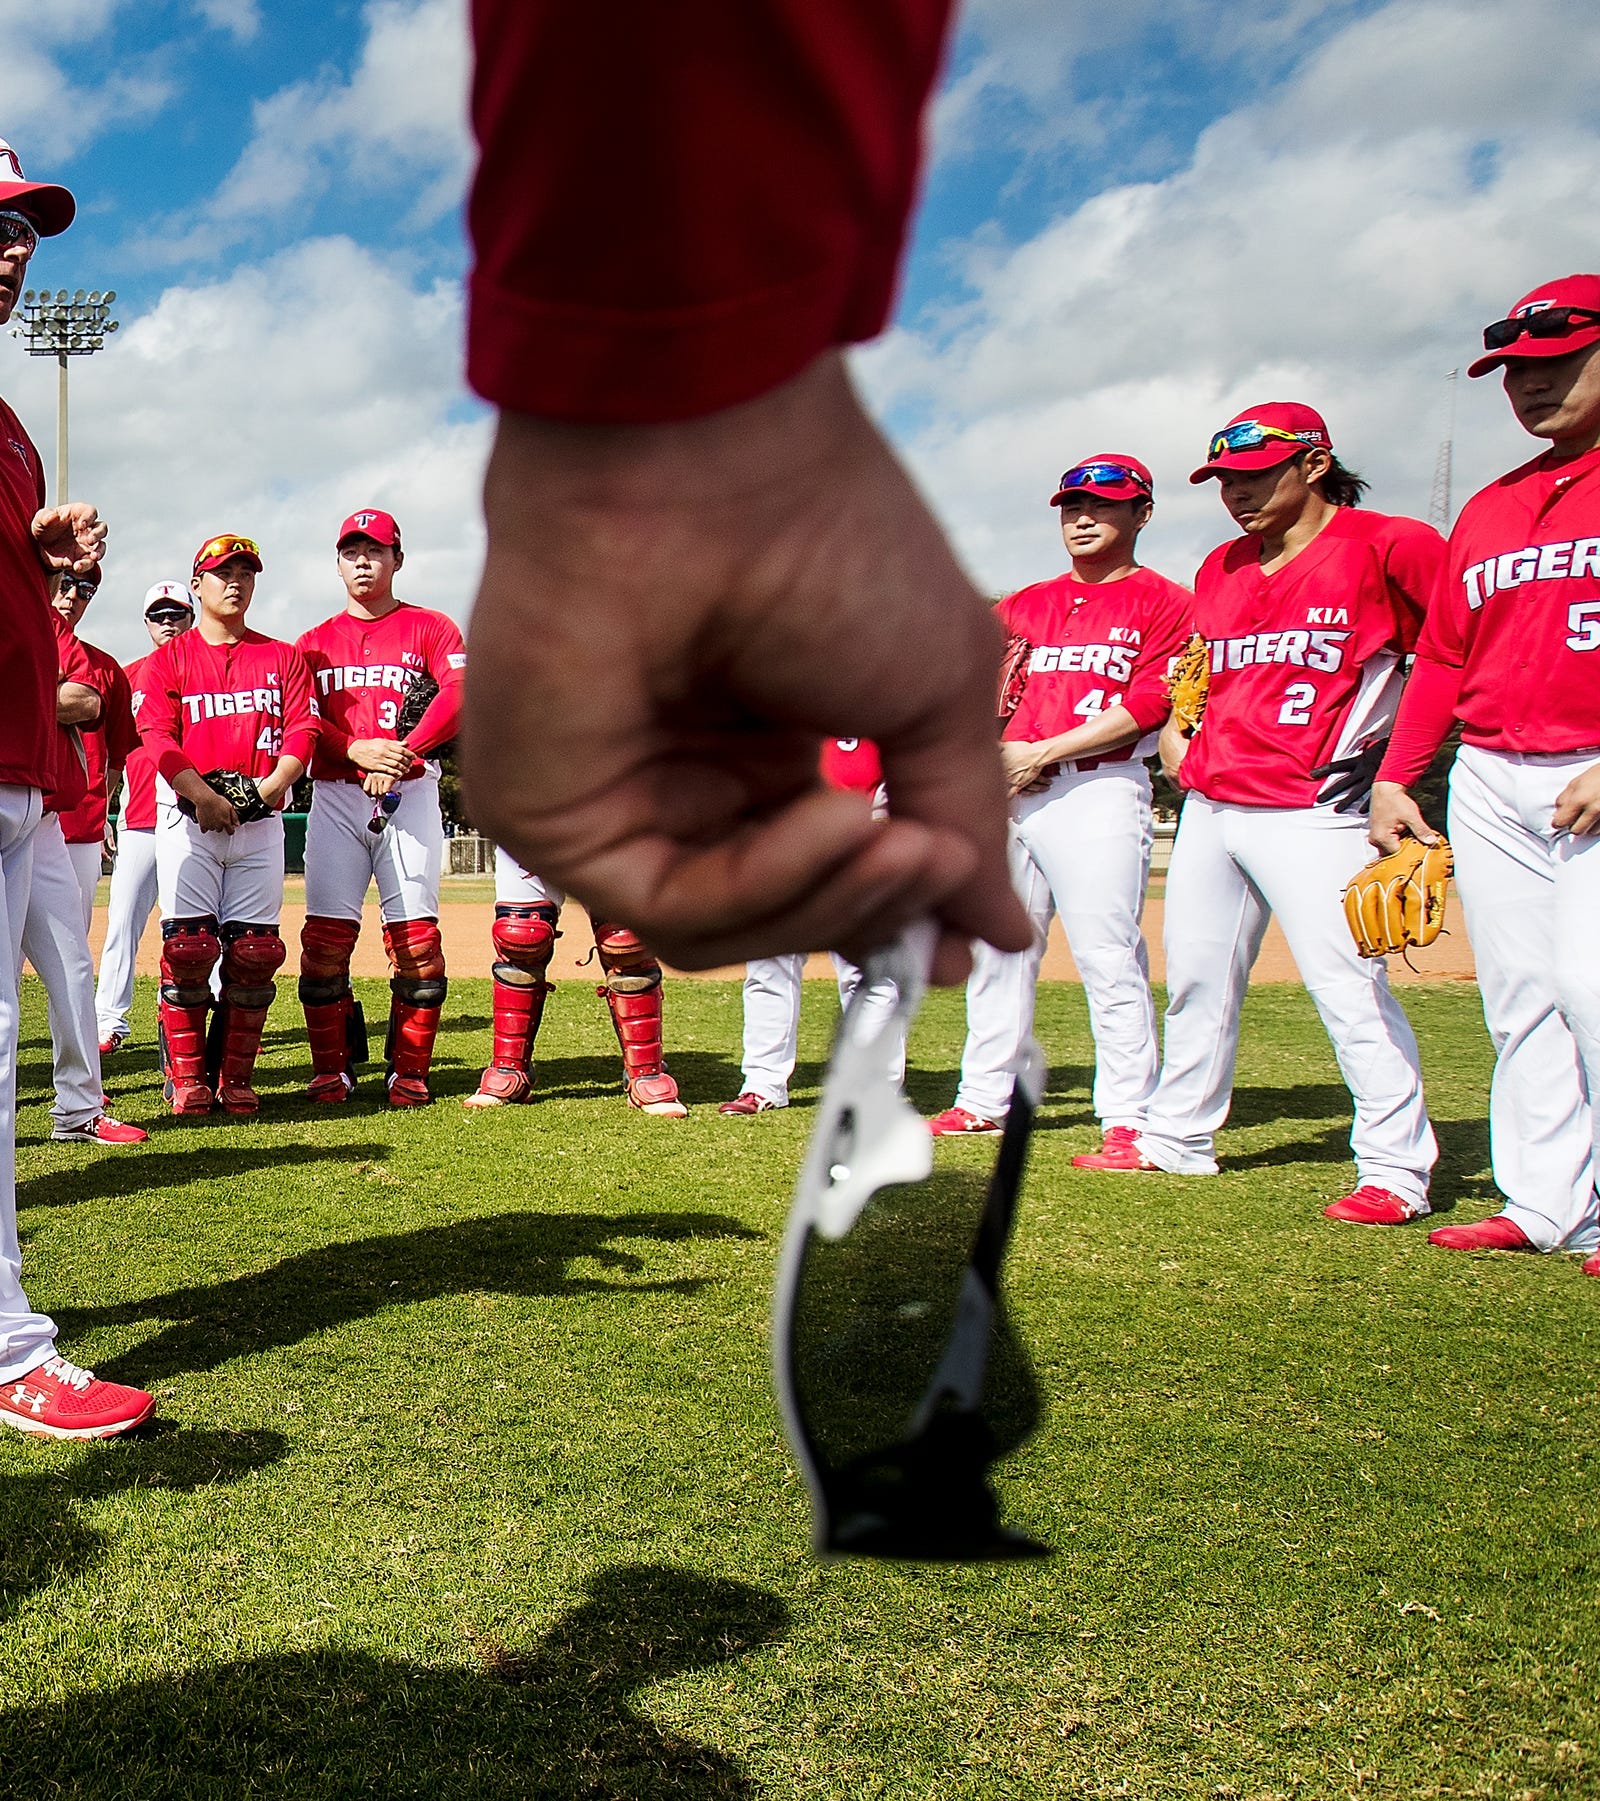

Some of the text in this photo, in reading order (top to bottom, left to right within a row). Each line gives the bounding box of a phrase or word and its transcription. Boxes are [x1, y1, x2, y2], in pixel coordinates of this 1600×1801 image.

[354, 513, 377, 529] T
[1462, 536, 1600, 611] TIGER
[1306, 607, 1348, 625] KIA
[1108, 627, 1141, 645] KIA
[401, 651, 425, 668] KIA
[1027, 644, 1140, 684] IGERS
[1206, 630, 1354, 674] IGERS
[1278, 682, 1318, 726] 2
